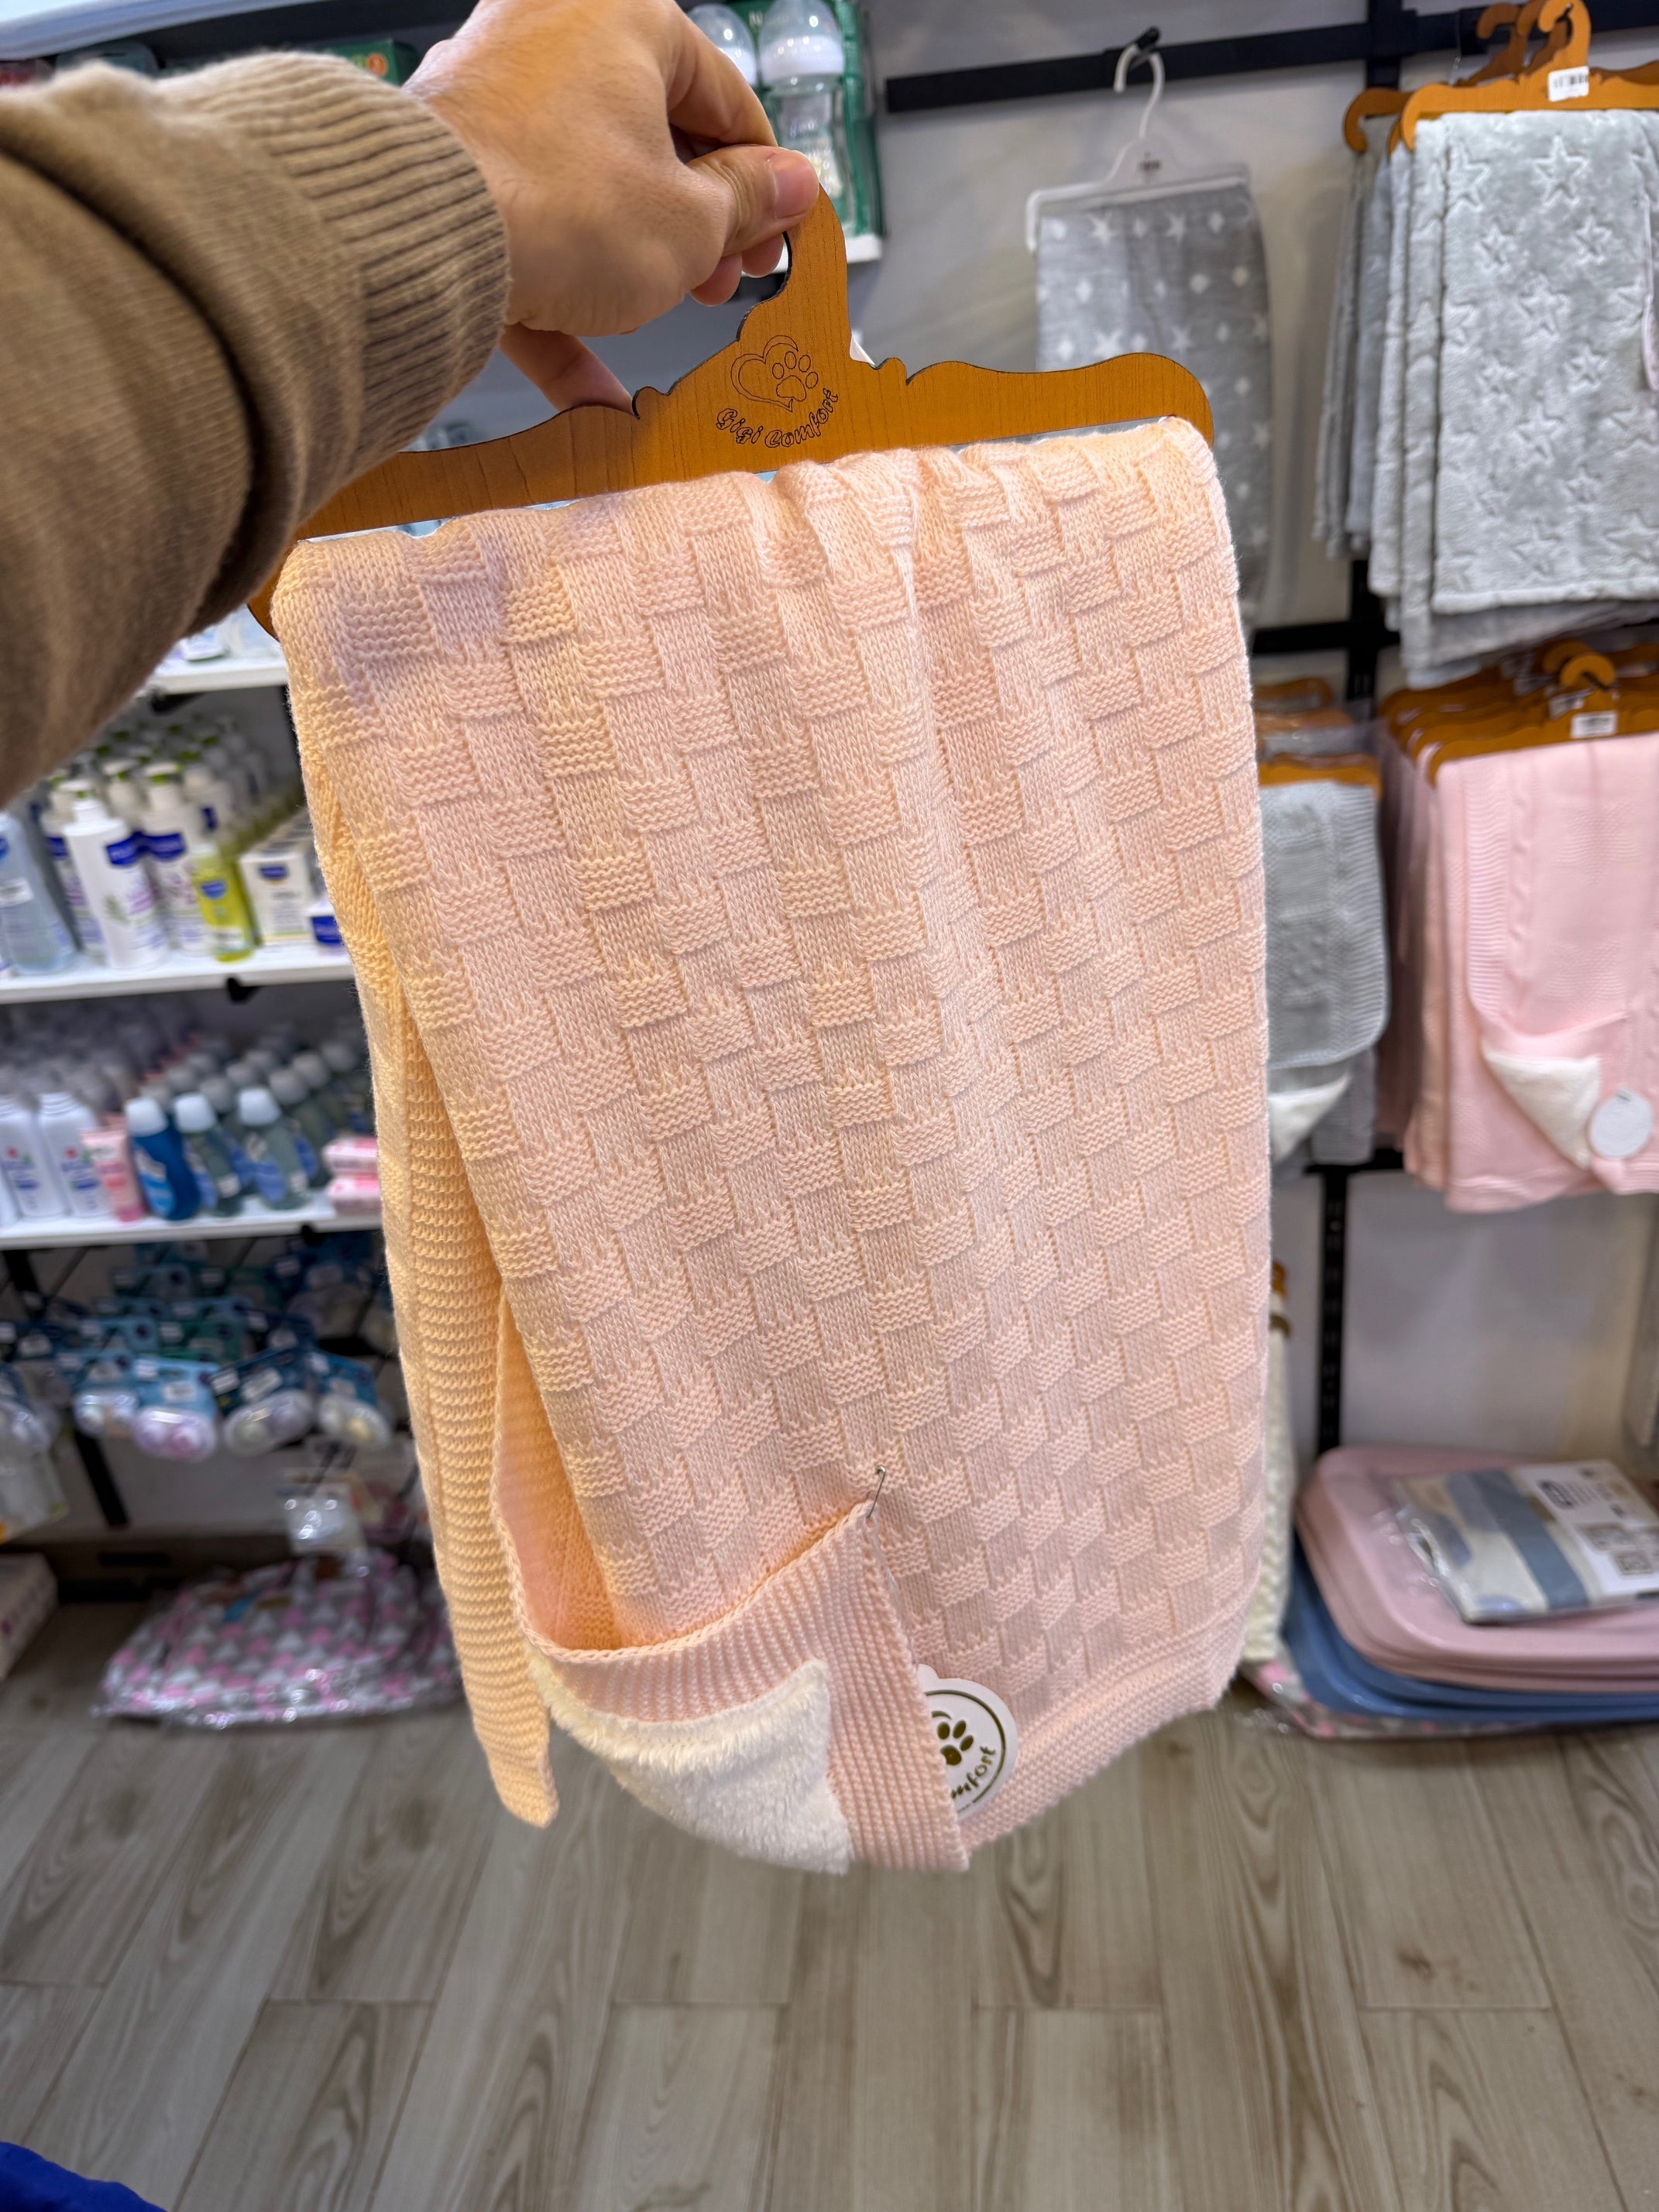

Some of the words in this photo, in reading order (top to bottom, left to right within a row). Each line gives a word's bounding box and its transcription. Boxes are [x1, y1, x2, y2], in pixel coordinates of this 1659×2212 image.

[716, 408, 764, 445] Gigi
[764, 388, 839, 448] Comfort
[951, 1746, 996, 1799] mfort
